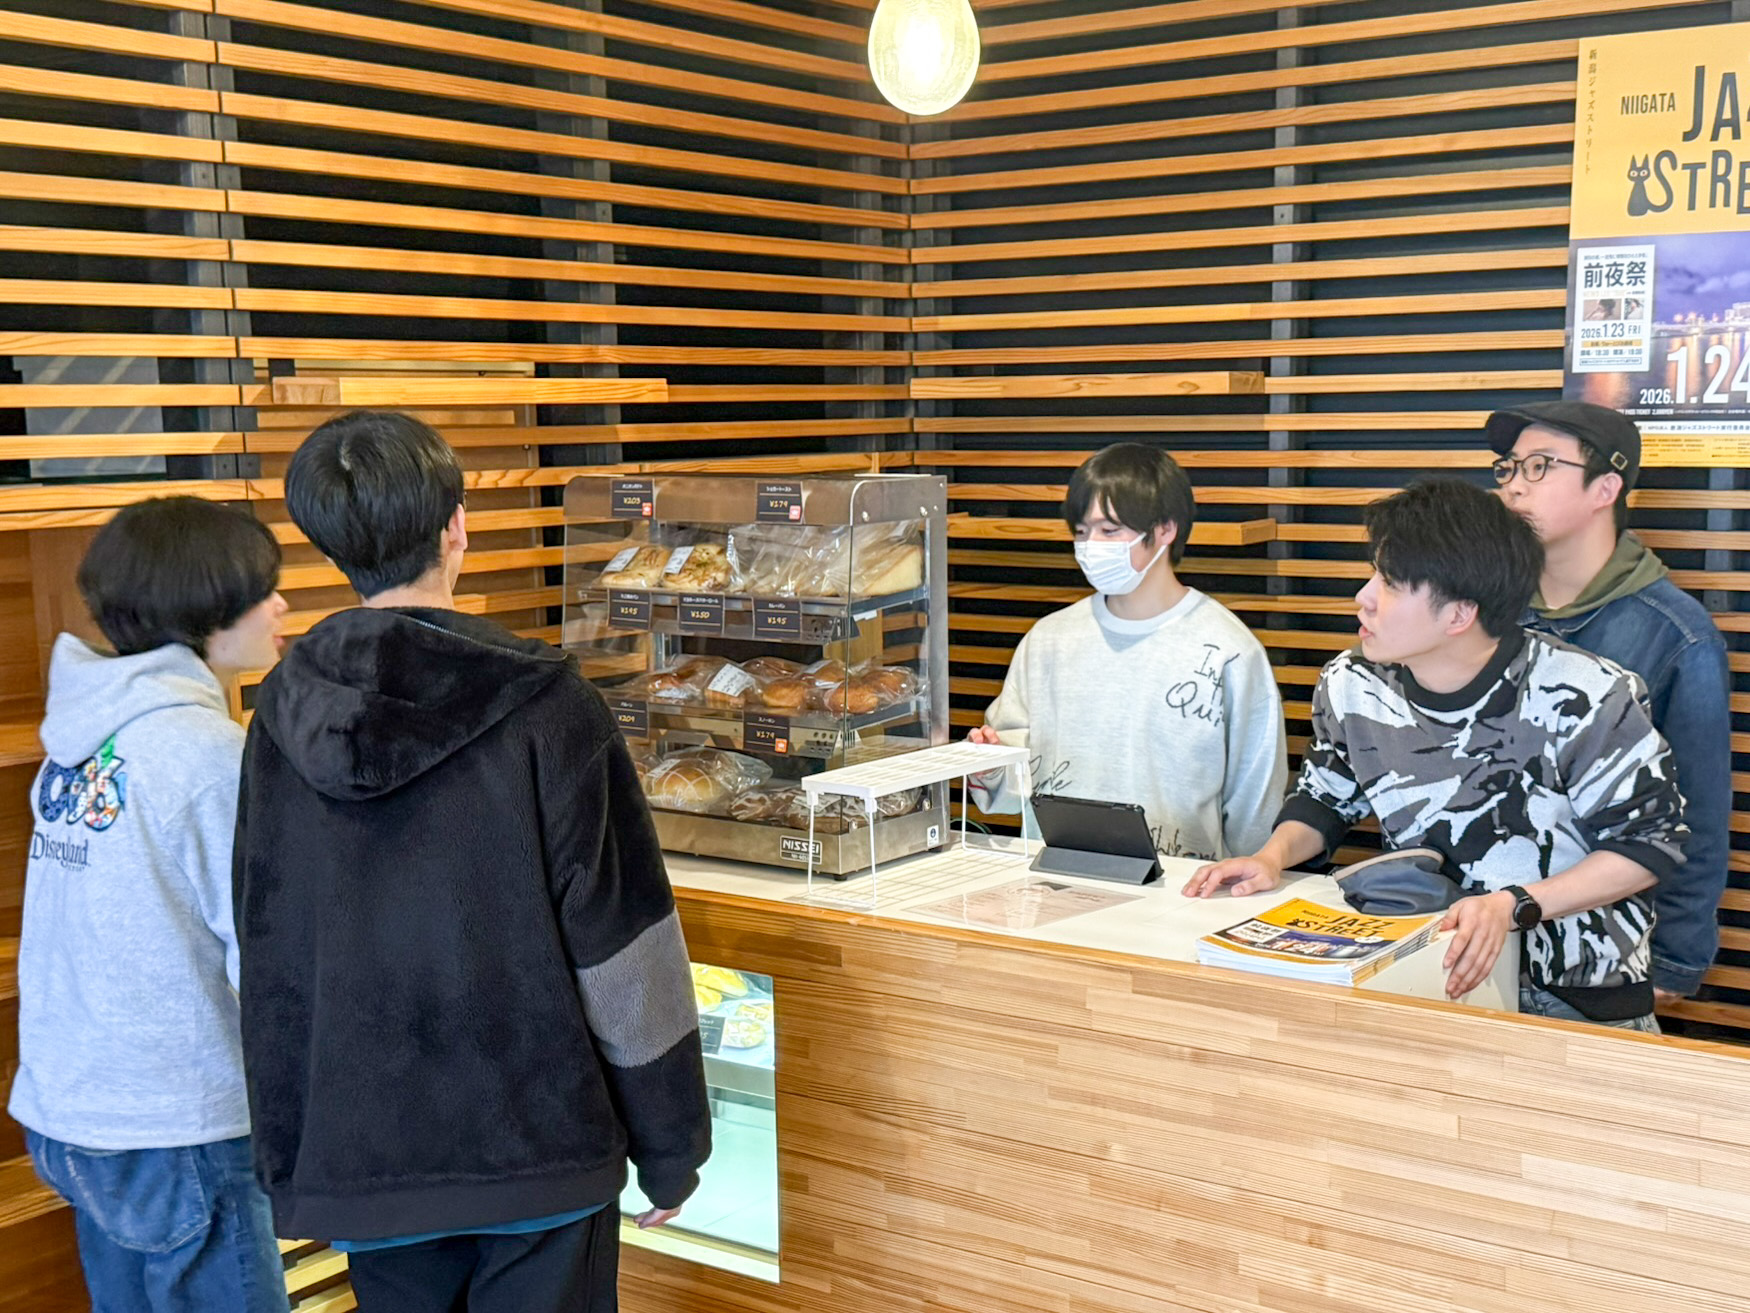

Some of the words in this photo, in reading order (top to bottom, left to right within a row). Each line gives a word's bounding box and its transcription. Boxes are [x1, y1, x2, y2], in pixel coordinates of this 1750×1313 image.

[1620, 92, 1676, 115] NIIGATA
[1682, 64, 1750, 142] JA
[1583, 260, 1647, 289] 前夜祭
[1581, 322, 1625, 339] 2026.1.23
[1628, 325, 1641, 335] FRI
[782, 838, 820, 854] NISSEI
[1301, 920, 1385, 937] STREET
[1325, 915, 1396, 930] JAZZ
